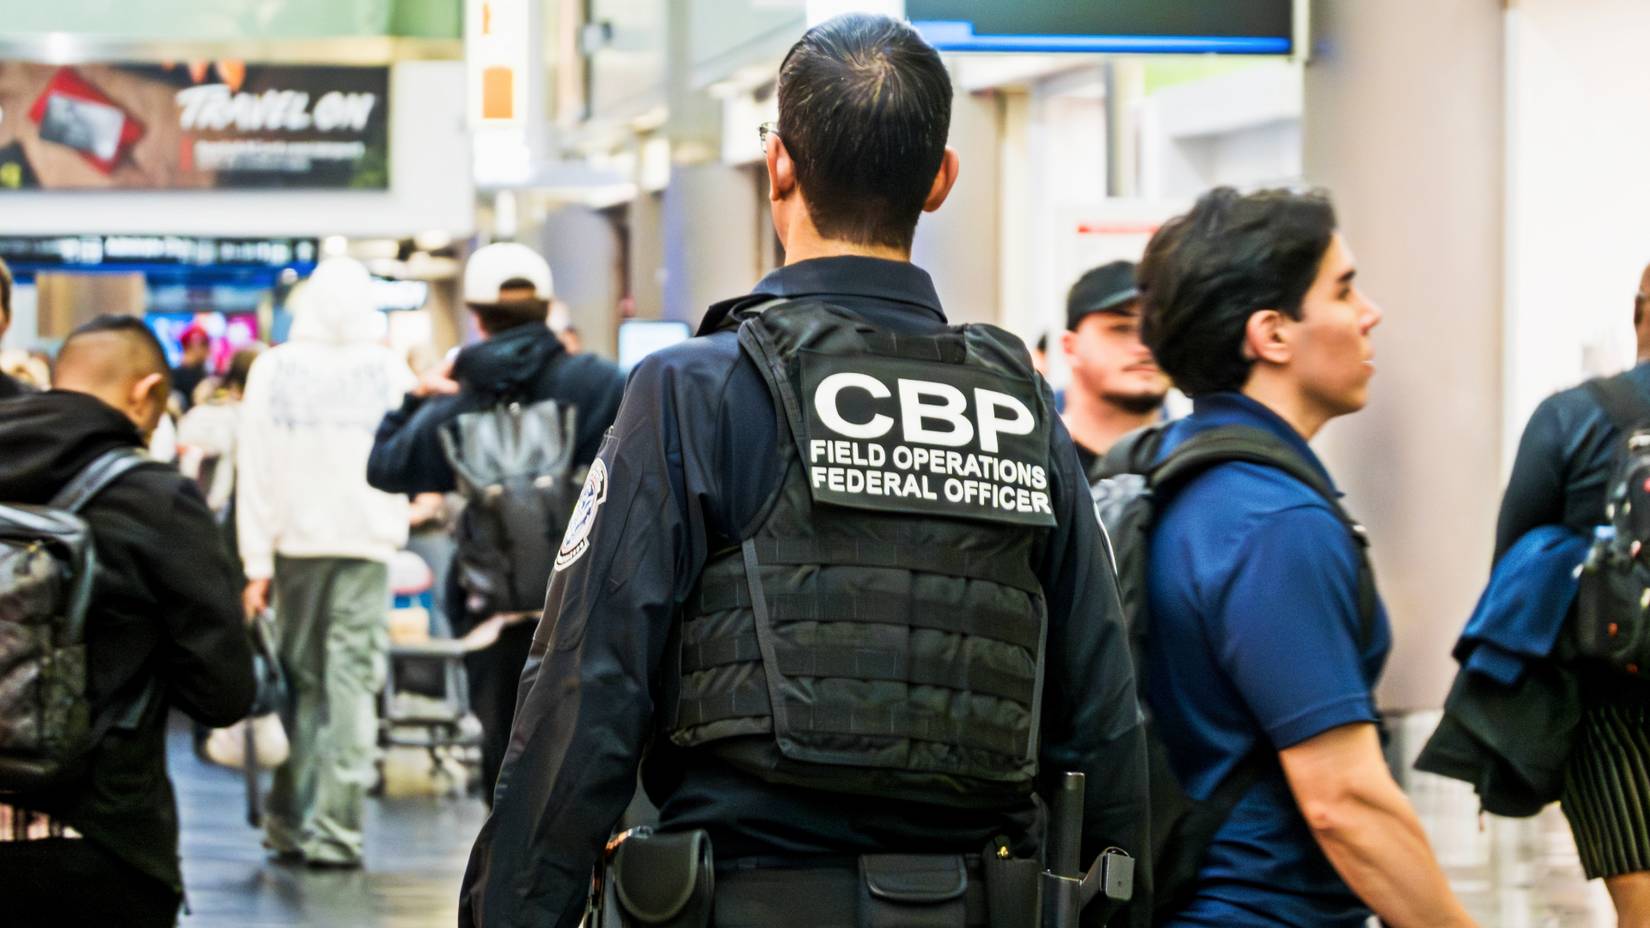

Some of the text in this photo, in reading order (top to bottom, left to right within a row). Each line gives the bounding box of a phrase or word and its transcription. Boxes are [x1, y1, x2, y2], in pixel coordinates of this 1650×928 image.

[176, 84, 376, 132] TRAVEL ON
[814, 372, 1035, 453] CBP
[810, 439, 1047, 490] FIELD OPERATIONS
[811, 466, 1052, 514] FEDERAL OFFICER
